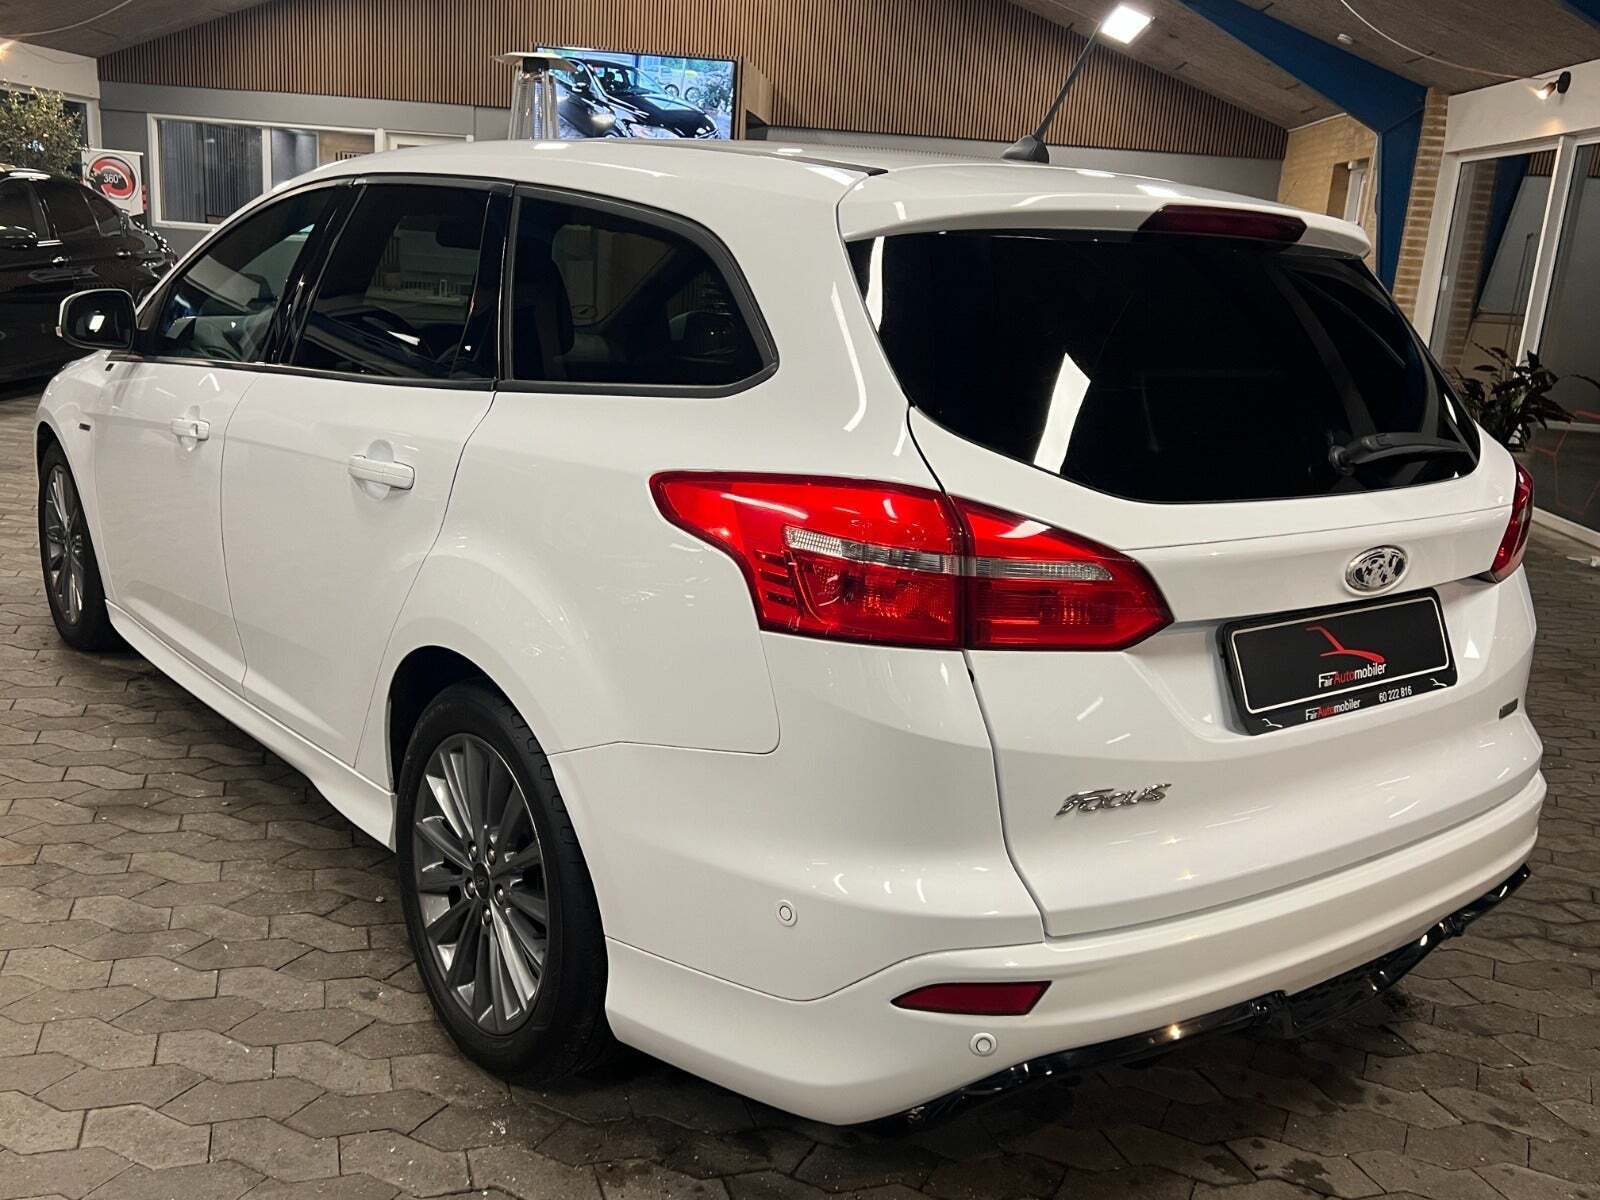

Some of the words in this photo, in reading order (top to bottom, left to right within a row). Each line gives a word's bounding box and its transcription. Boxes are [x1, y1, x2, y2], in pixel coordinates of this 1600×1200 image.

[1379, 691, 1388, 703] 60
[1388, 688, 1400, 701] 222
[1400, 685, 1413, 698] 816
